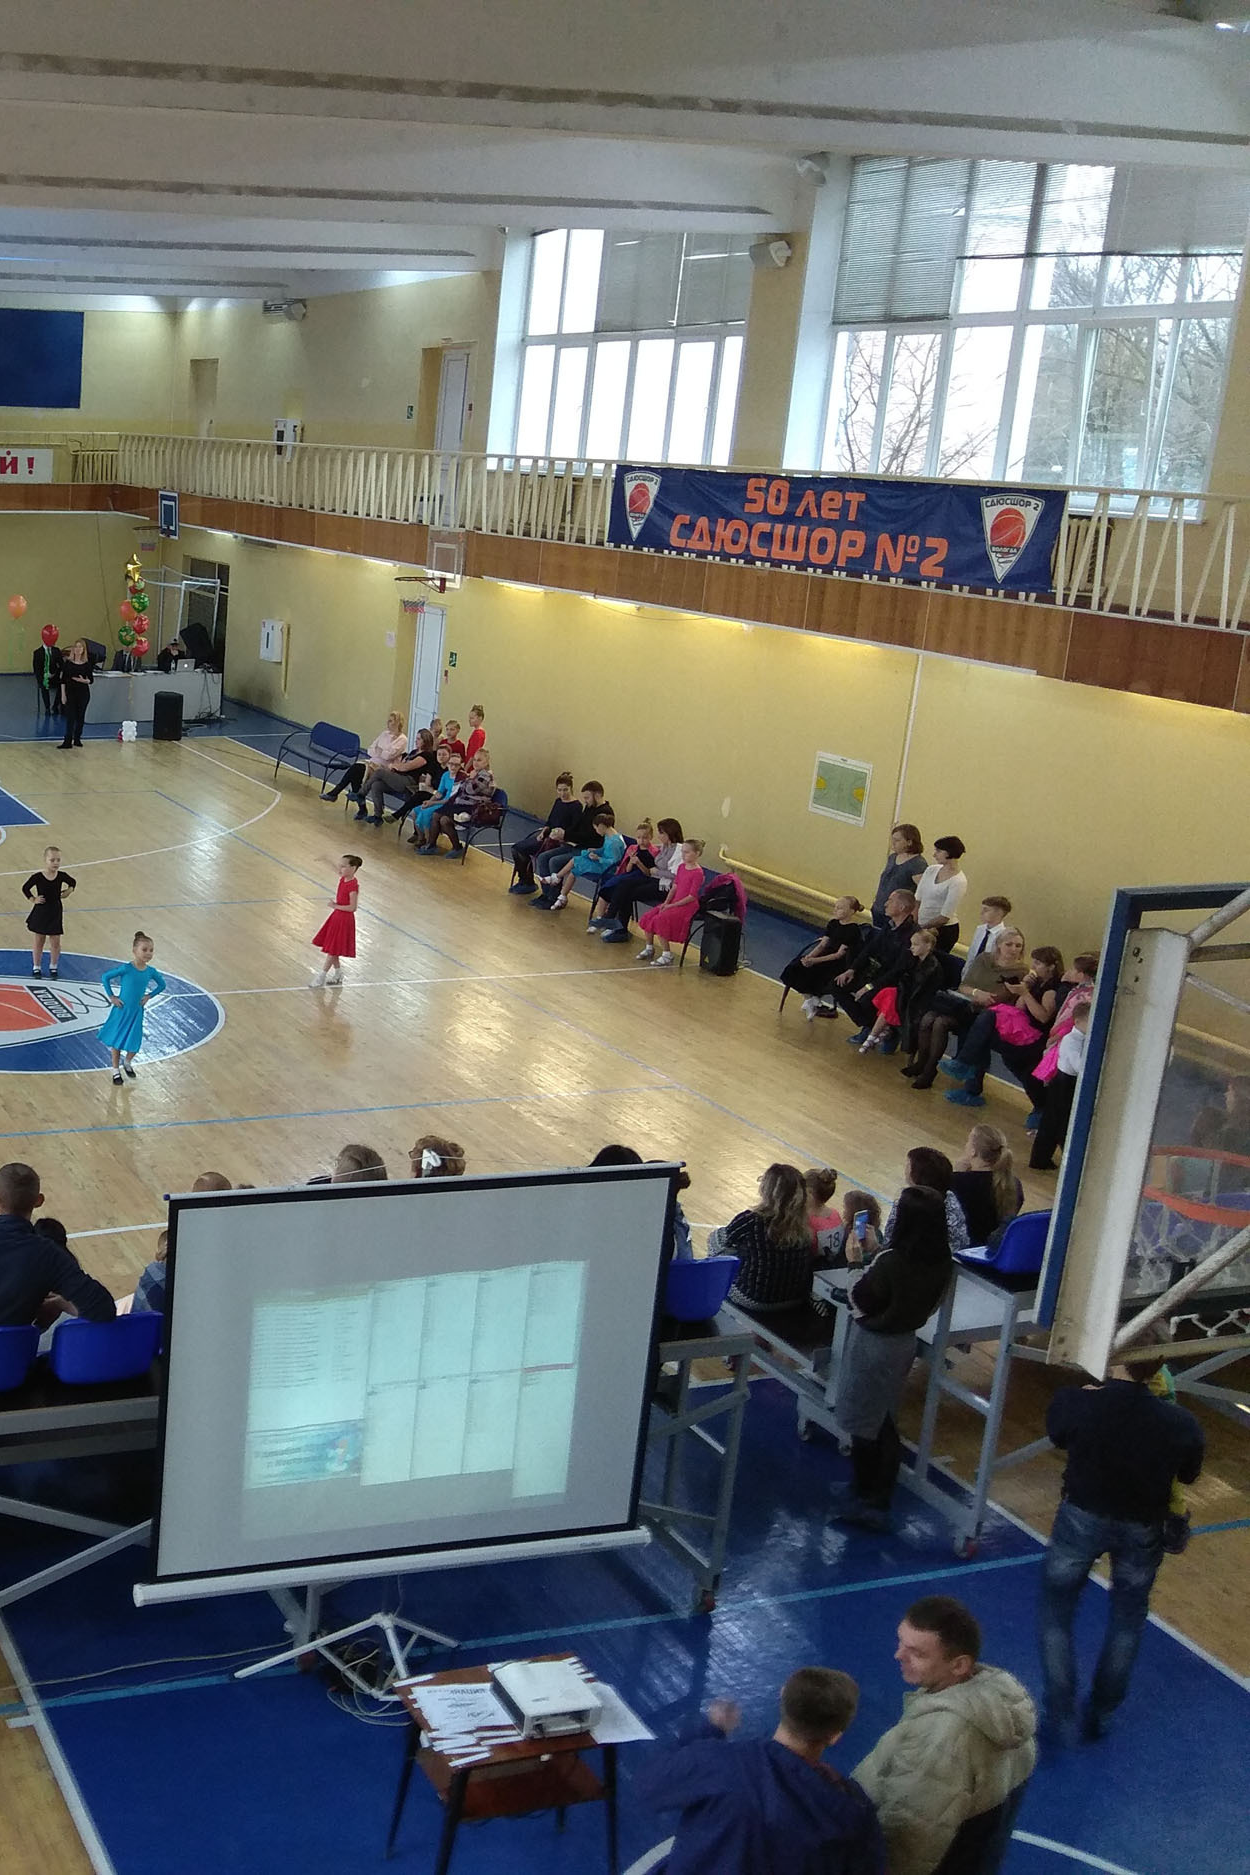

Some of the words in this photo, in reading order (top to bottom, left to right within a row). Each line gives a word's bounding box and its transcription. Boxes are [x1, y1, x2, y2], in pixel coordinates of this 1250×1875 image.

[744, 478, 790, 516] 50
[794, 489, 866, 521] лет
[985, 497, 1032, 508] СДЮСШОР
[1032, 502, 1040, 511] 2
[669, 514, 866, 567] СДЮСШОР
[873, 533, 948, 578] №2
[824, 1231, 840, 1249] 18
